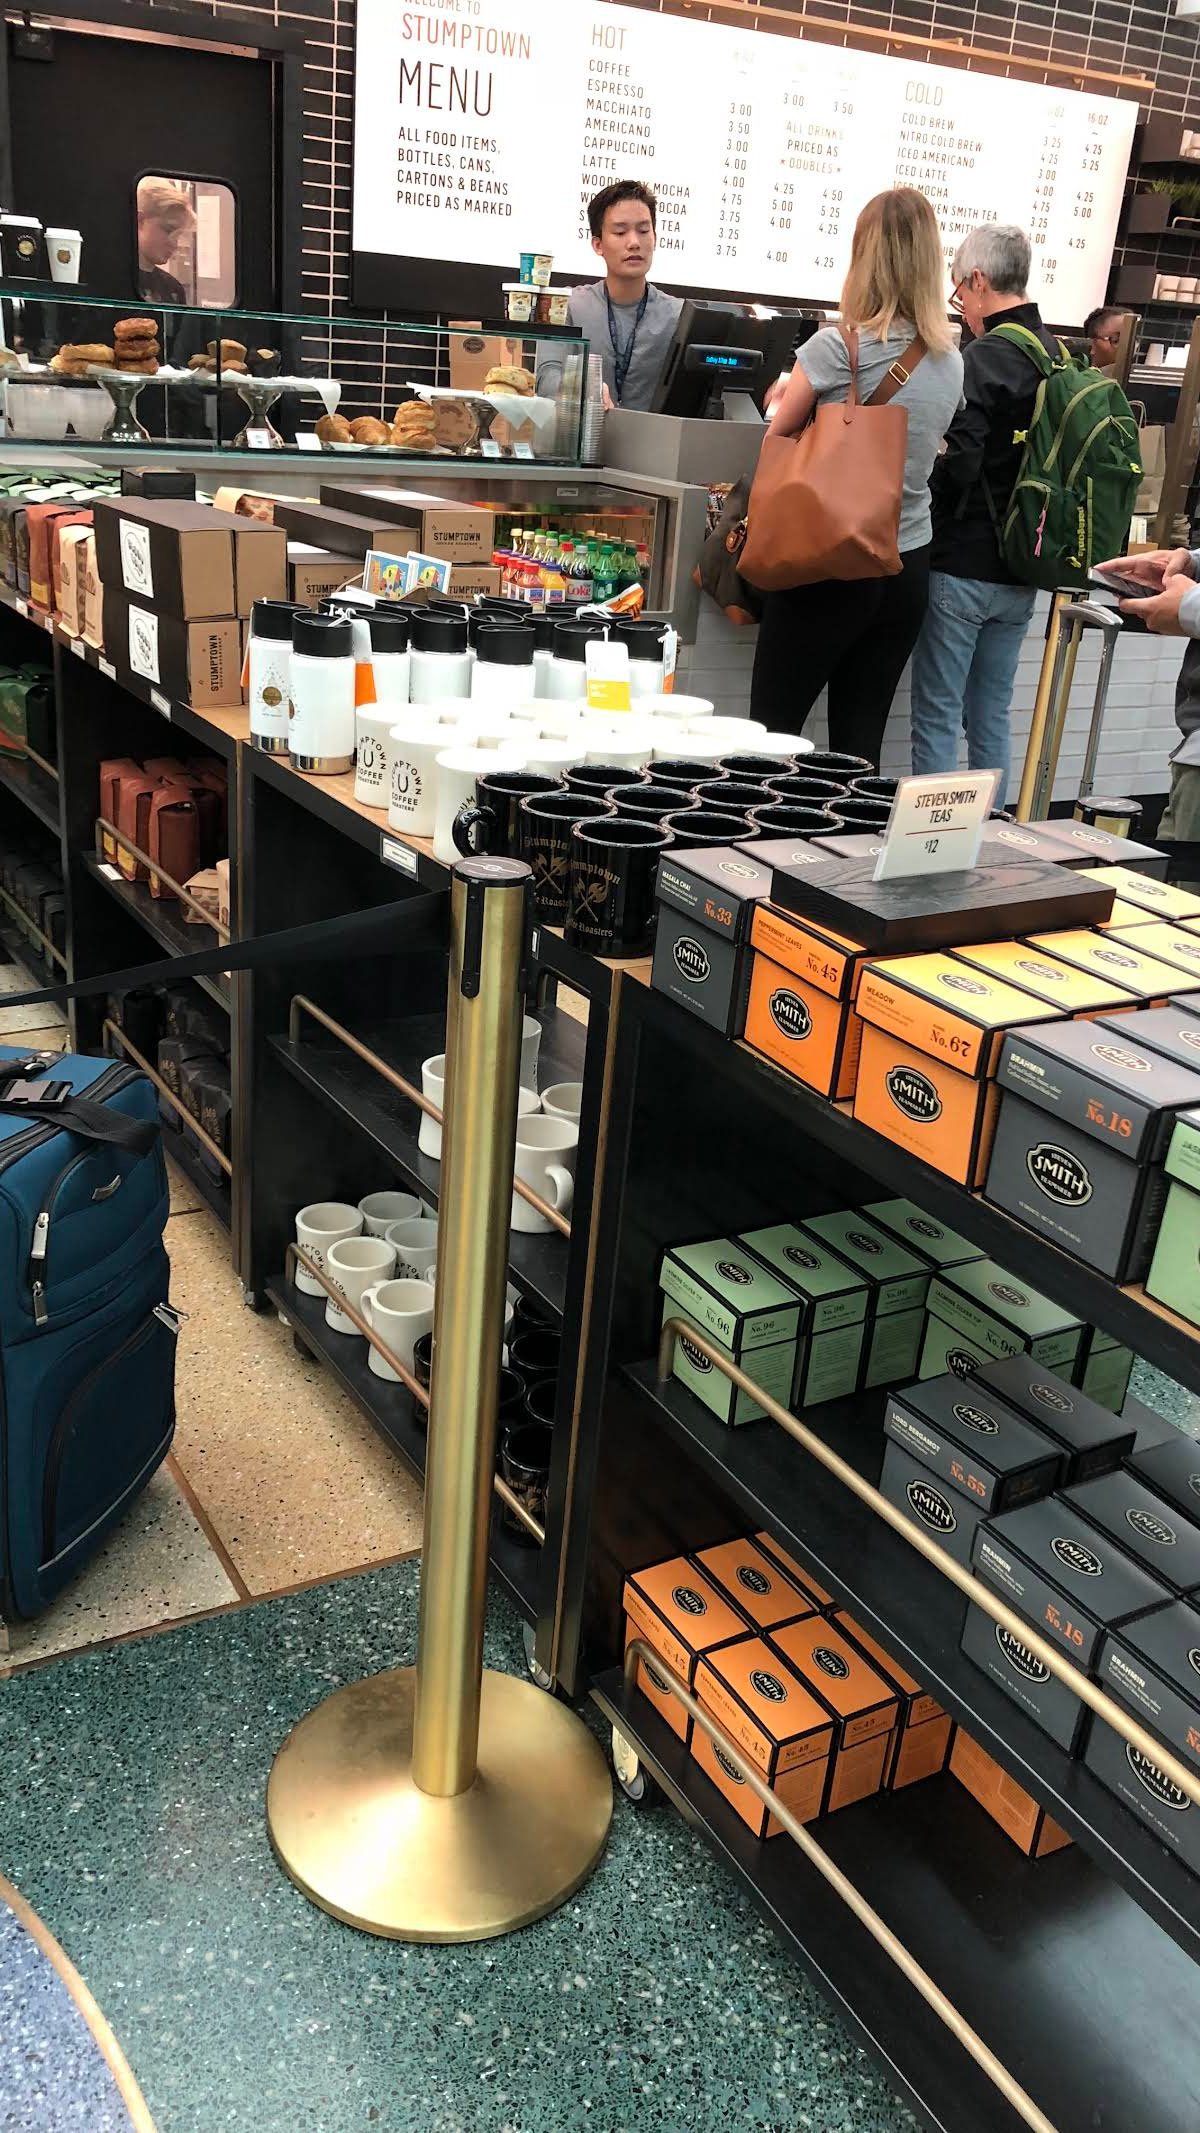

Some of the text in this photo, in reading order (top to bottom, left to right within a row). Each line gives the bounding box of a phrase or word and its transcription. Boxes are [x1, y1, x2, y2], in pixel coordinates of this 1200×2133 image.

[466, 0, 481, 15] TO
[402, 13, 530, 59] STUMPTOWN
[592, 24, 628, 50] HOT
[589, 59, 630, 77] COFFEE
[399, 58, 492, 116] MENU
[588, 79, 643, 98] ESPRESSO
[905, 81, 942, 106] COLD
[586, 98, 650, 118] MACCHIATO
[585, 117, 650, 137] AMERICANO
[902, 112, 955, 130] COLD BREW
[398, 126, 500, 154] ALL FOOD ITEMS,
[584, 136, 655, 156] CAPPUCCINO
[727, 139, 748, 152] 3.00
[788, 139, 838, 157] PRICED AS
[900, 130, 983, 152] NITRO COLD BREW
[897, 147, 974, 168] ICED AMERICANO
[1085, 144, 1102, 155] 4.25
[398, 148, 494, 173] BOTTLES, CANS,
[583, 155, 616, 169] LATTE
[725, 158, 746, 170] 4.00
[723, 176, 744, 187] 4.00
[896, 164, 947, 181] ICED LATTE
[397, 170, 508, 195] CARTONS & BEANS
[654, 183, 690, 198] MOCHA
[774, 183, 794, 194] 4.25
[918, 185, 948, 198] MOCHA
[1036, 186, 1054, 196] 4.00
[397, 190, 512, 216] PRICED AS MARKED
[722, 193, 742, 205] 4.75
[823, 189, 843, 201] 4.50
[1077, 192, 1093, 202] 4.25
[656, 202, 687, 215] OCOA
[772, 200, 792, 212] 5.00
[821, 206, 840, 218] 5.25
[952, 206, 997, 221] SMITH TEA
[1074, 206, 1091, 218] 5.00
[720, 210, 740, 222] 3.75
[770, 217, 791, 229] 4.00
[662, 220, 680, 232] TEA
[719, 228, 739, 239] 3.25
[819, 223, 838, 234] 4.25
[659, 238, 685, 250] CHAI
[717, 244, 737, 256] 3.75
[1069, 238, 1085, 248] 4.25
[767, 251, 787, 262] 4.00
[814, 257, 834, 267] 4.25
[1041, 258, 1056, 269] 1.00
[433, 532, 481, 542] STUMPTOWN
[450, 585, 491, 594] TUMPTOWN
[567, 583, 591, 596] Coke
[209, 635, 219, 692] STUMPTOWN
[914, 790, 977, 808] STEVEN SMITH
[929, 809, 952, 823] TEAS
[924, 839, 939, 853] $12
[677, 946, 705, 973] SMITH
[866, 986, 895, 1005] MEADOW
[774, 1000, 806, 1029] SMITH
[1010, 1053, 1045, 1077] BRAHMIN
[893, 1078, 935, 1111] SMITH
[1034, 1156, 1083, 1194] SMITH
[791, 1248, 815, 1268] SMITH
[722, 1263, 747, 1283] SMITH
[997, 1286, 1025, 1305] SMITH
[1036, 1385, 1069, 1410] SMITH
[959, 1407, 994, 1432] SMITH
[892, 1413, 908, 1428] LORD
[909, 1424, 941, 1452] BERGAMOT
[912, 1489, 950, 1525] SMITH
[1133, 1512, 1170, 1541] SMITH
[1058, 1541, 1095, 1573] SMITH
[743, 1569, 765, 1592] SMITH
[678, 1590, 701, 1614] SMITH
[818, 1651, 844, 1675] SMITH
[1112, 1654, 1146, 1688] BRAHMIN
[756, 1674, 781, 1699] SMITH
